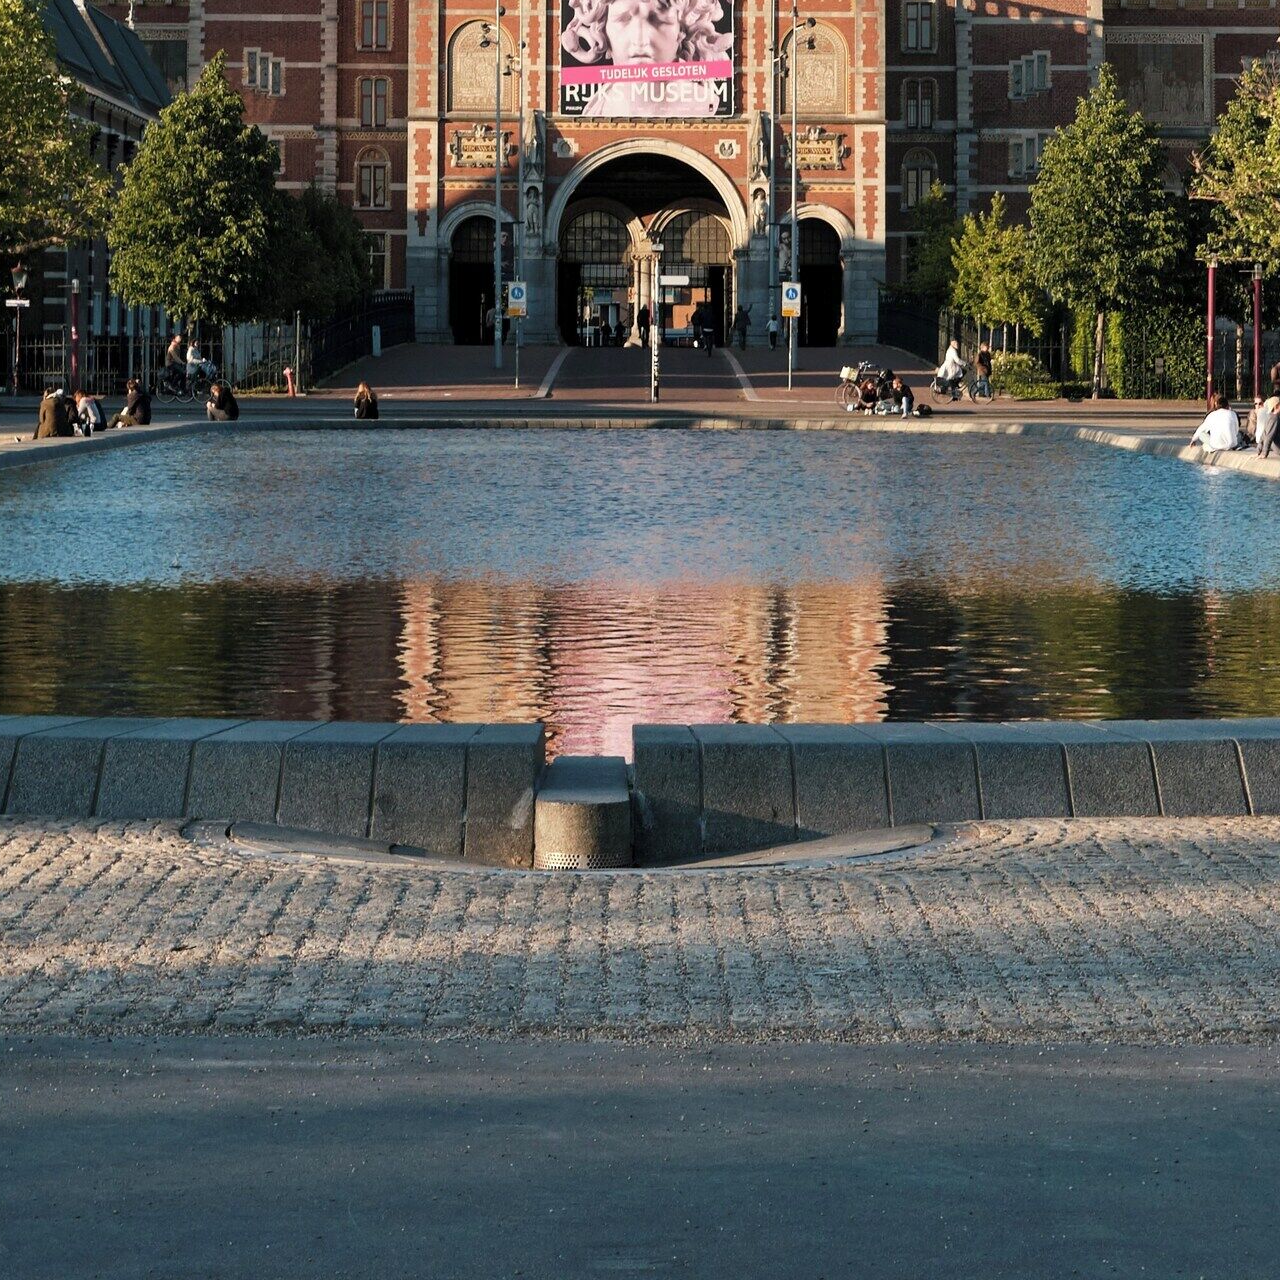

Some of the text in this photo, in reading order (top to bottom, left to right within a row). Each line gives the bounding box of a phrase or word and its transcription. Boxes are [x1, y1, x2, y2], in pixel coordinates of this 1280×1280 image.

[651, 65, 707, 78] GESLOTEN
[565, 82, 728, 103] RIJKS MUSEUM
